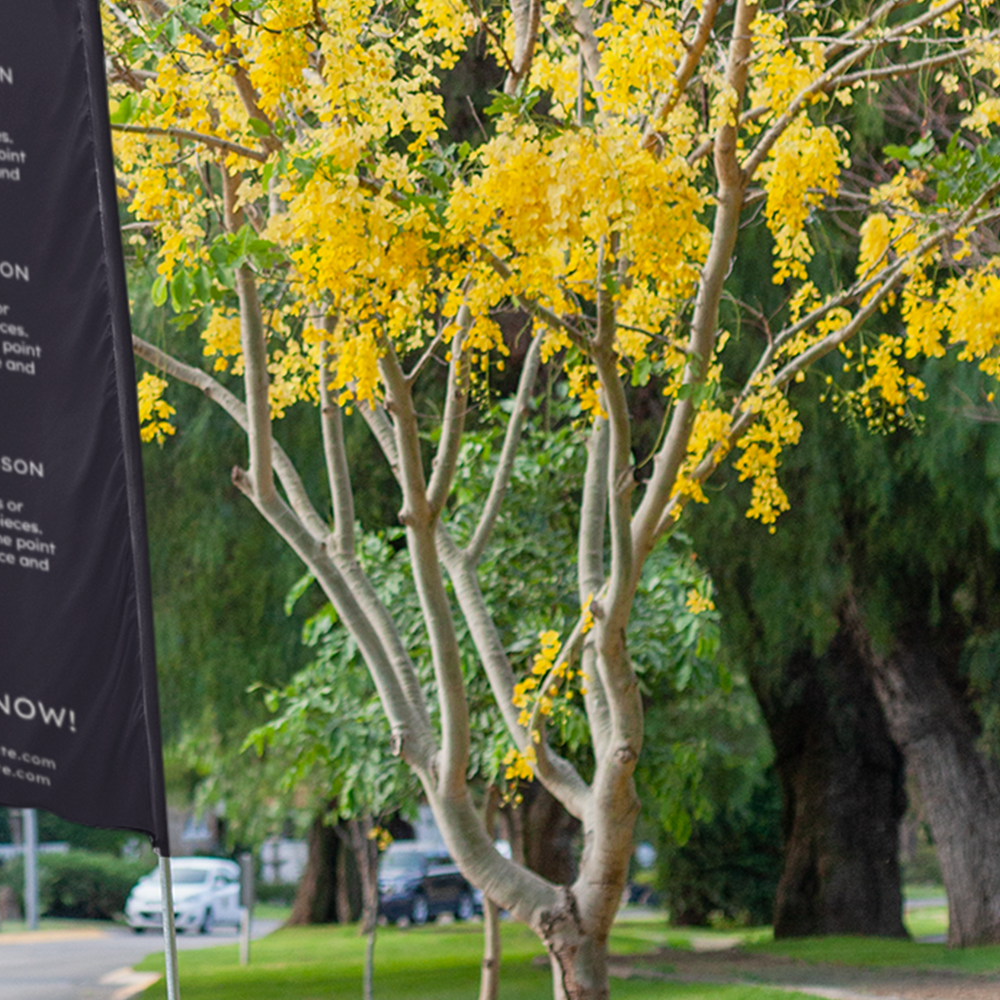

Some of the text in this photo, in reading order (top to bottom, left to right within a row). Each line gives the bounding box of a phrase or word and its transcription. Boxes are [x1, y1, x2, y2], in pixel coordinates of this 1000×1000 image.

[2, 338, 41, 358] point
[5, 358, 35, 375] and
[7, 500, 24, 512] or
[16, 535, 56, 555] point
[19, 554, 50, 572] and
